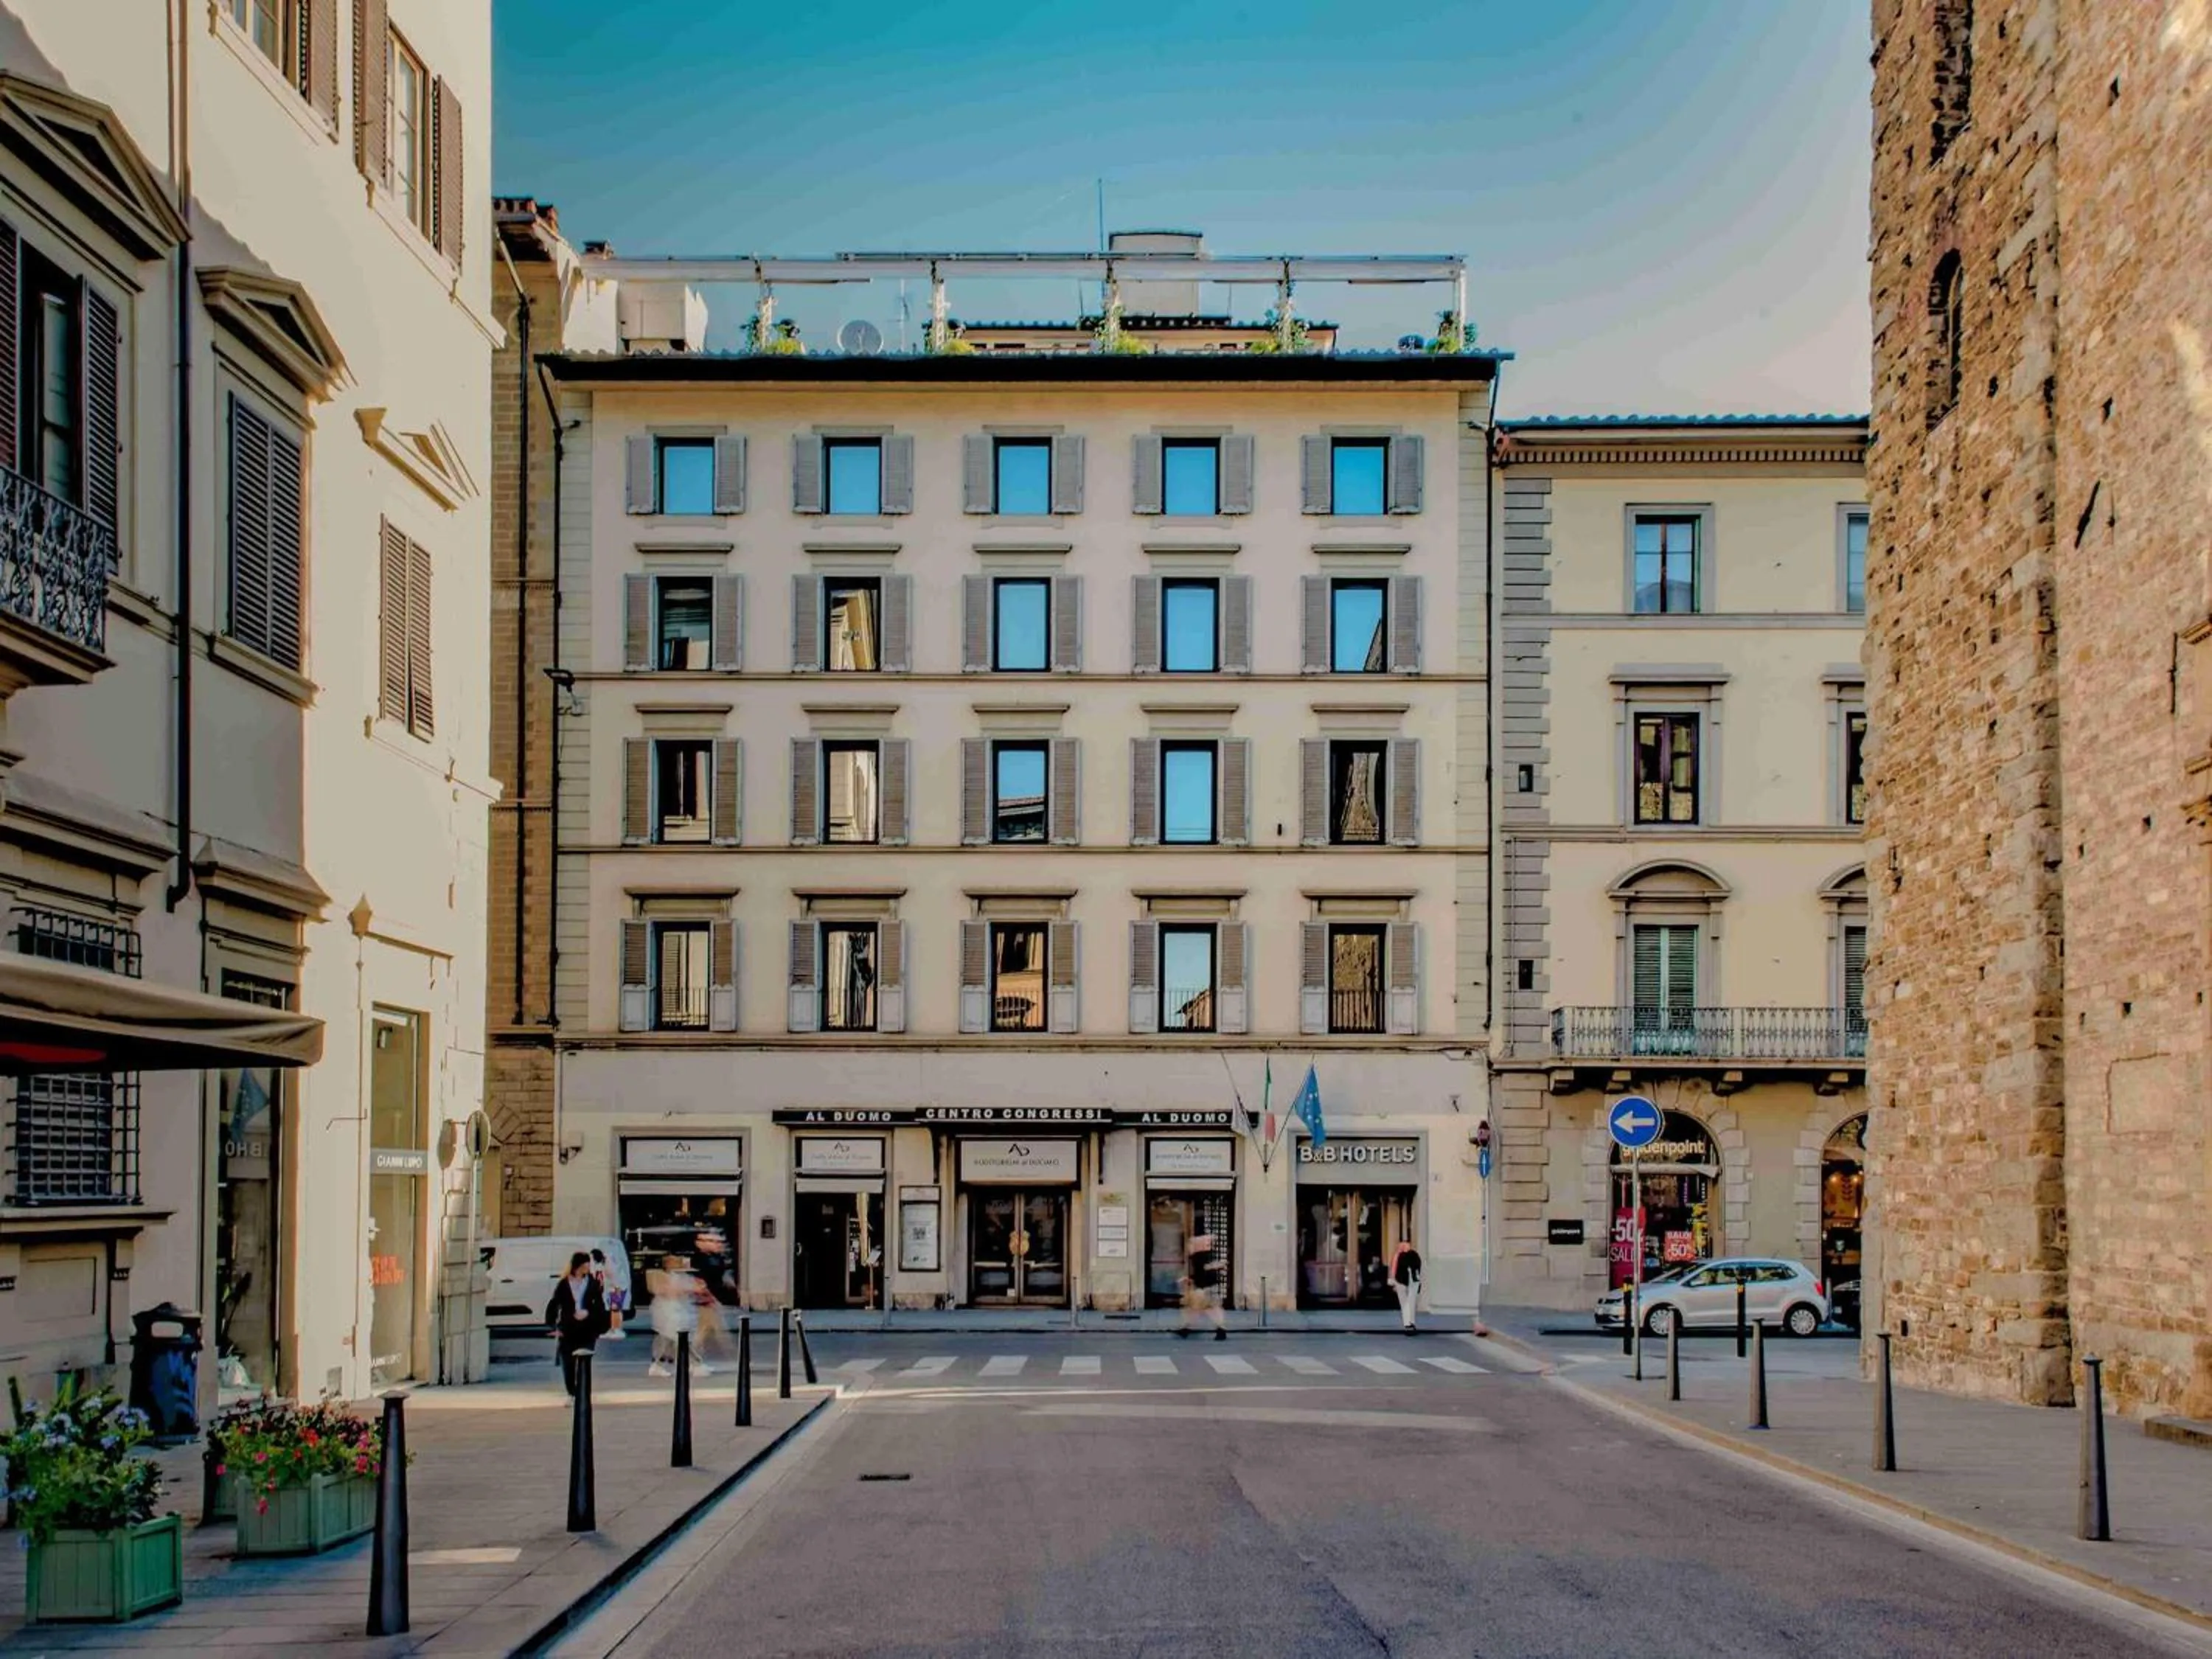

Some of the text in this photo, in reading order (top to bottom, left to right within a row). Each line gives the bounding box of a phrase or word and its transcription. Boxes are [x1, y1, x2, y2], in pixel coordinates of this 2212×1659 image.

[805, 1110, 892, 1121] AL DUOMO
[925, 1108, 1102, 1119] CENTRO CONGRESSI
[1141, 1113, 1228, 1123] AL DUOMO
[1300, 1144, 1415, 1163] B&B HOTELS
[1623, 1139, 1705, 1156] gdenpoint
[1610, 1247, 1637, 1262] SALD
